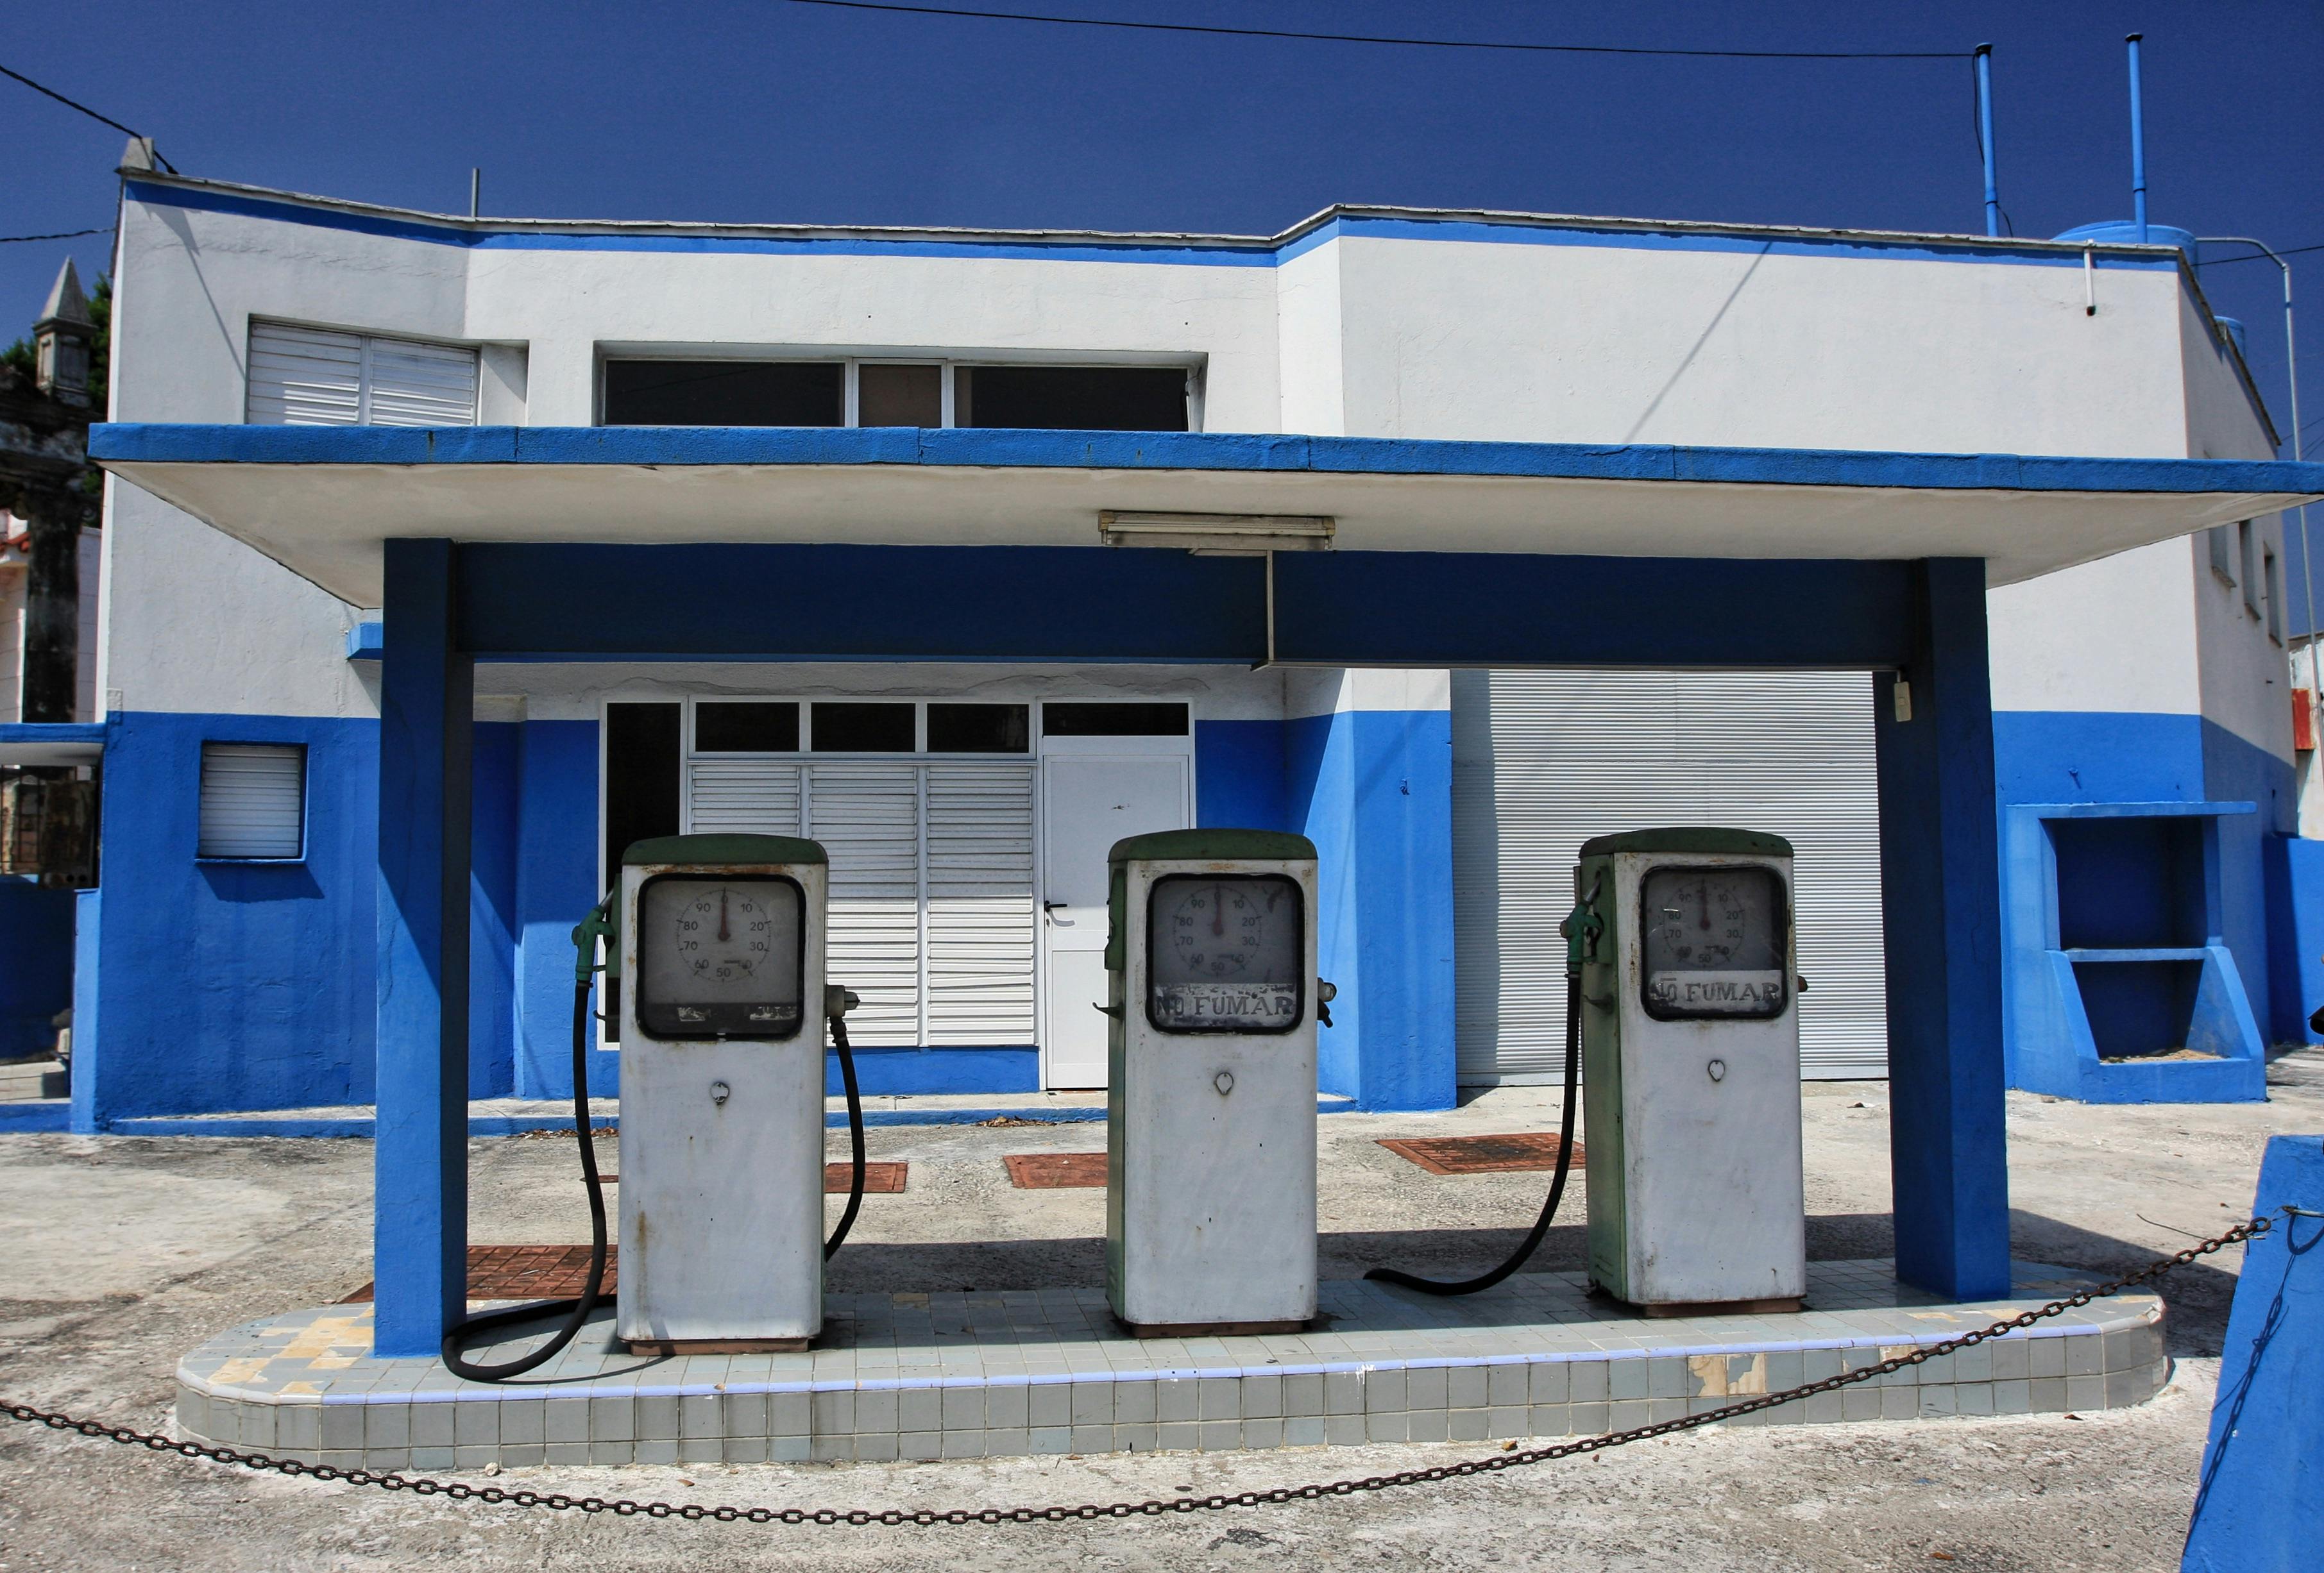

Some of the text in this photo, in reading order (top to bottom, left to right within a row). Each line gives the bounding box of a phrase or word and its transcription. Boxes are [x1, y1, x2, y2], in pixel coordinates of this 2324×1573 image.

[1679, 894, 1692, 902] 90
[1718, 894, 1728, 902] 10
[696, 903, 711, 912] 90
[740, 904, 752, 913] 10
[1191, 900, 1205, 908] 90
[1234, 900, 1244, 908] 10
[1668, 911, 1681, 920] 80
[1726, 911, 1739, 920] 20
[683, 921, 698, 930] 80
[750, 921, 764, 931] 20
[1180, 917, 1193, 927] 80
[1242, 917, 1255, 927] 20
[1668, 929, 1682, 938] 70
[1726, 929, 1739, 938] 30
[1180, 936, 1193, 945] 70
[1242, 936, 1255, 946] 30
[683, 941, 698, 950] 70
[749, 941, 764, 951] 30
[1191, 954, 1204, 964] 60
[1699, 954, 1711, 963] 50
[695, 959, 709, 969] 60
[1211, 962, 1225, 971] 50
[717, 968, 731, 977] 50
[1685, 982, 1780, 1002] FUMAR
[1156, 995, 1294, 1016] NO FUMAR
